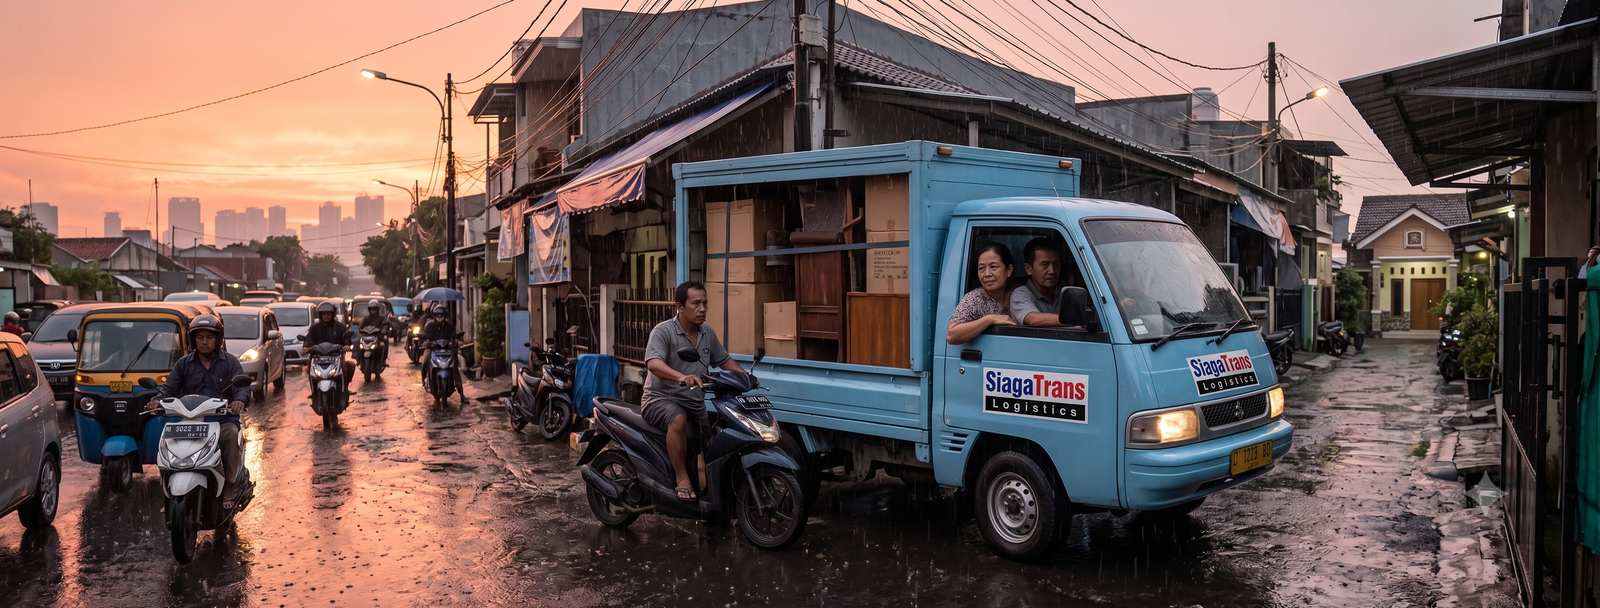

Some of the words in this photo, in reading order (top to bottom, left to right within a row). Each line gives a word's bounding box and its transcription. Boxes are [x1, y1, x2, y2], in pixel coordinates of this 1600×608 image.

[1190, 354, 1252, 378] SiagaTrans
[986, 370, 1086, 401] SiagaTrans
[1202, 375, 1254, 391] Logistics
[992, 398, 1077, 417] Logistics
